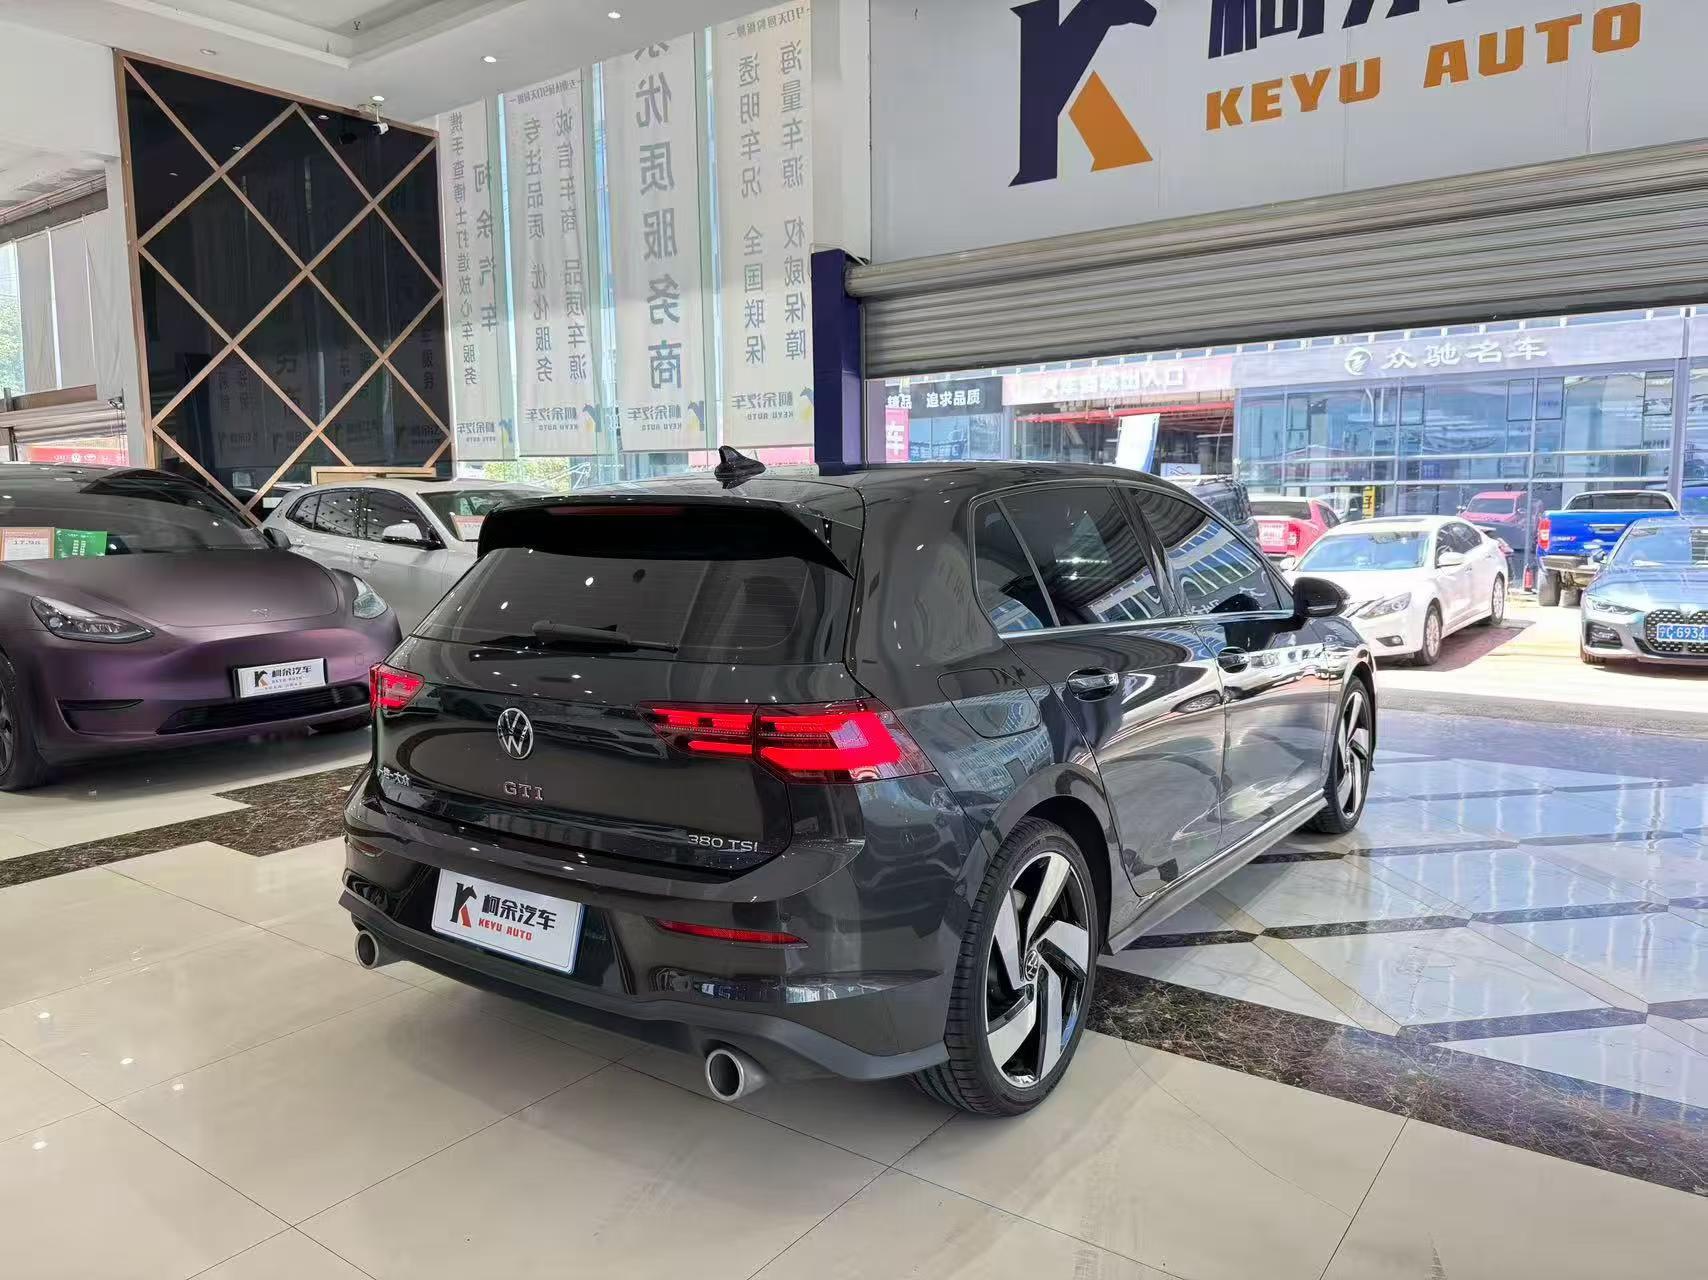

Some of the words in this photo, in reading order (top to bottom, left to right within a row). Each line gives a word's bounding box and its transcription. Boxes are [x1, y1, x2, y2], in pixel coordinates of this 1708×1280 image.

[1206, 56, 1382, 131] KEYU
[1423, 1, 1642, 88] AUTO
[1380, 336, 1549, 370] 众驰名车
[926, 387, 981, 409] 追求品质
[503, 780, 544, 801] GTI
[688, 833, 723, 849] 380
[728, 838, 759, 853] TSI
[482, 893, 558, 931] 柯余汽车
[478, 917, 504, 933] KEYU
[505, 926, 533, 942] AUTO
